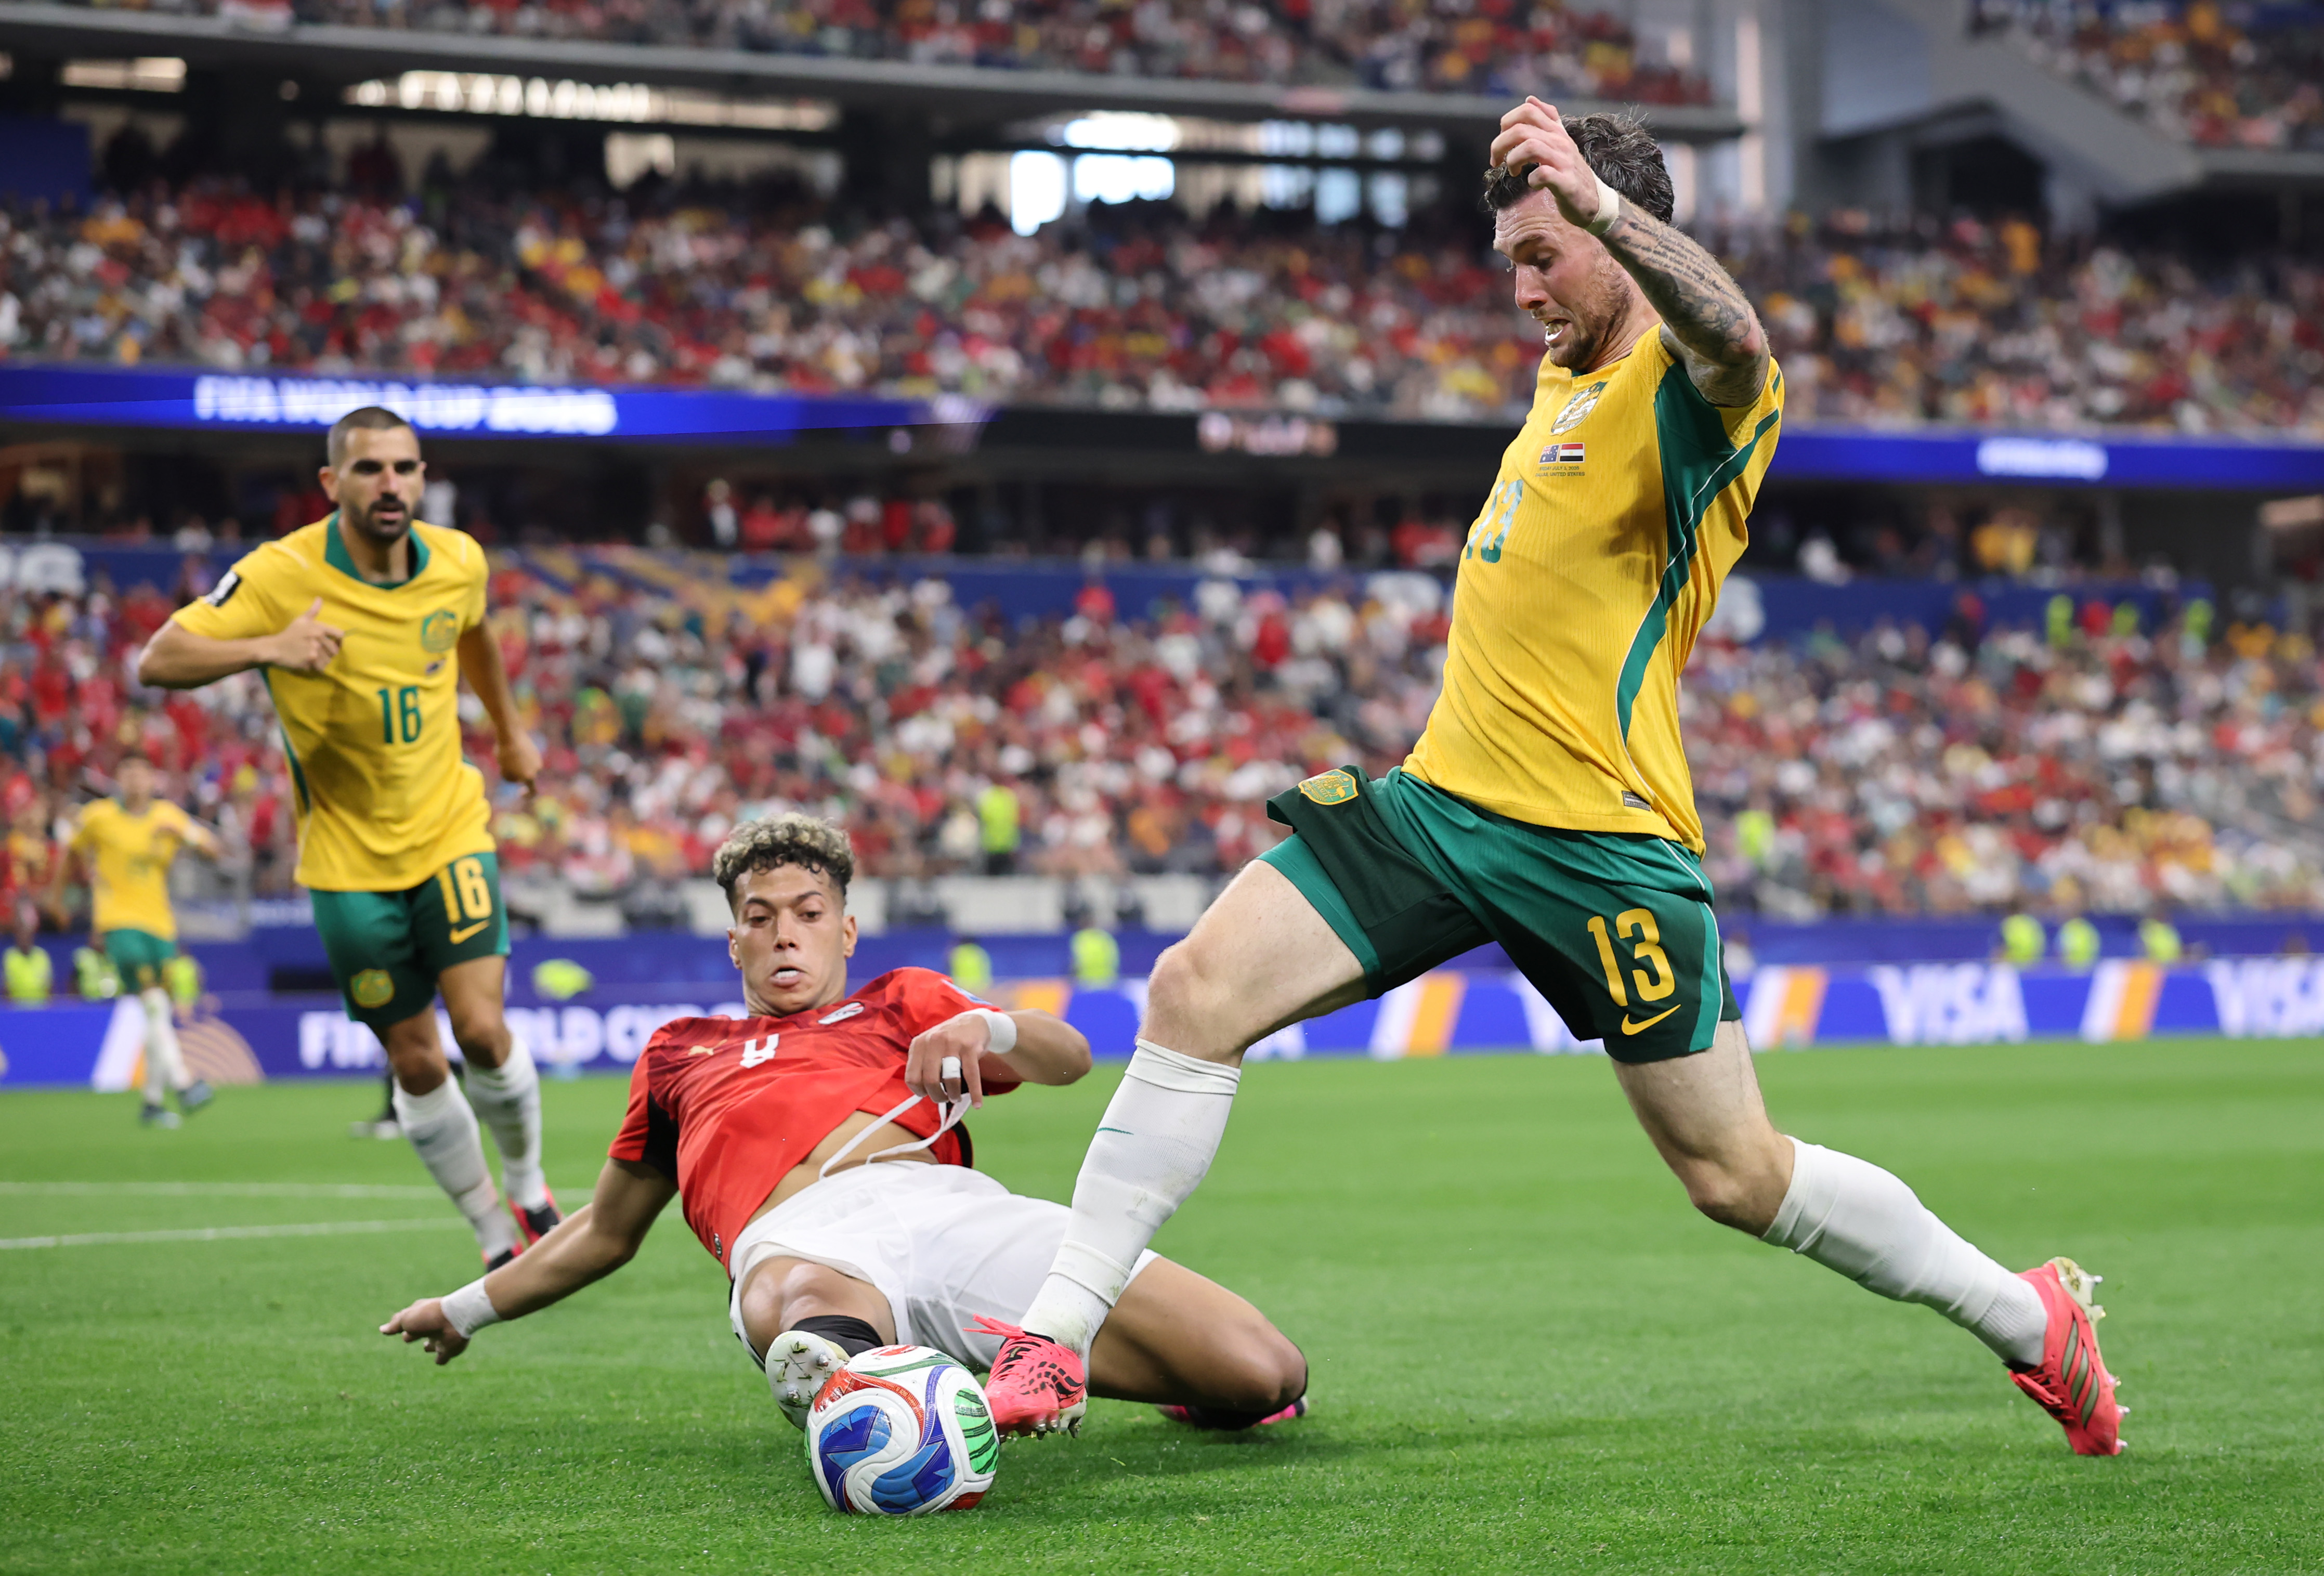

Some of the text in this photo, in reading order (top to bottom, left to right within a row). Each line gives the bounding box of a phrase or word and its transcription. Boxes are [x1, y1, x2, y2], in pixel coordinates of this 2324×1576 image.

[195, 375, 277, 422] FIFA
[1466, 479, 1524, 563] 13
[378, 686, 422, 744] 16
[436, 856, 492, 924] 16
[1587, 908, 1675, 1007] 13
[1868, 963, 2029, 1044] VISA
